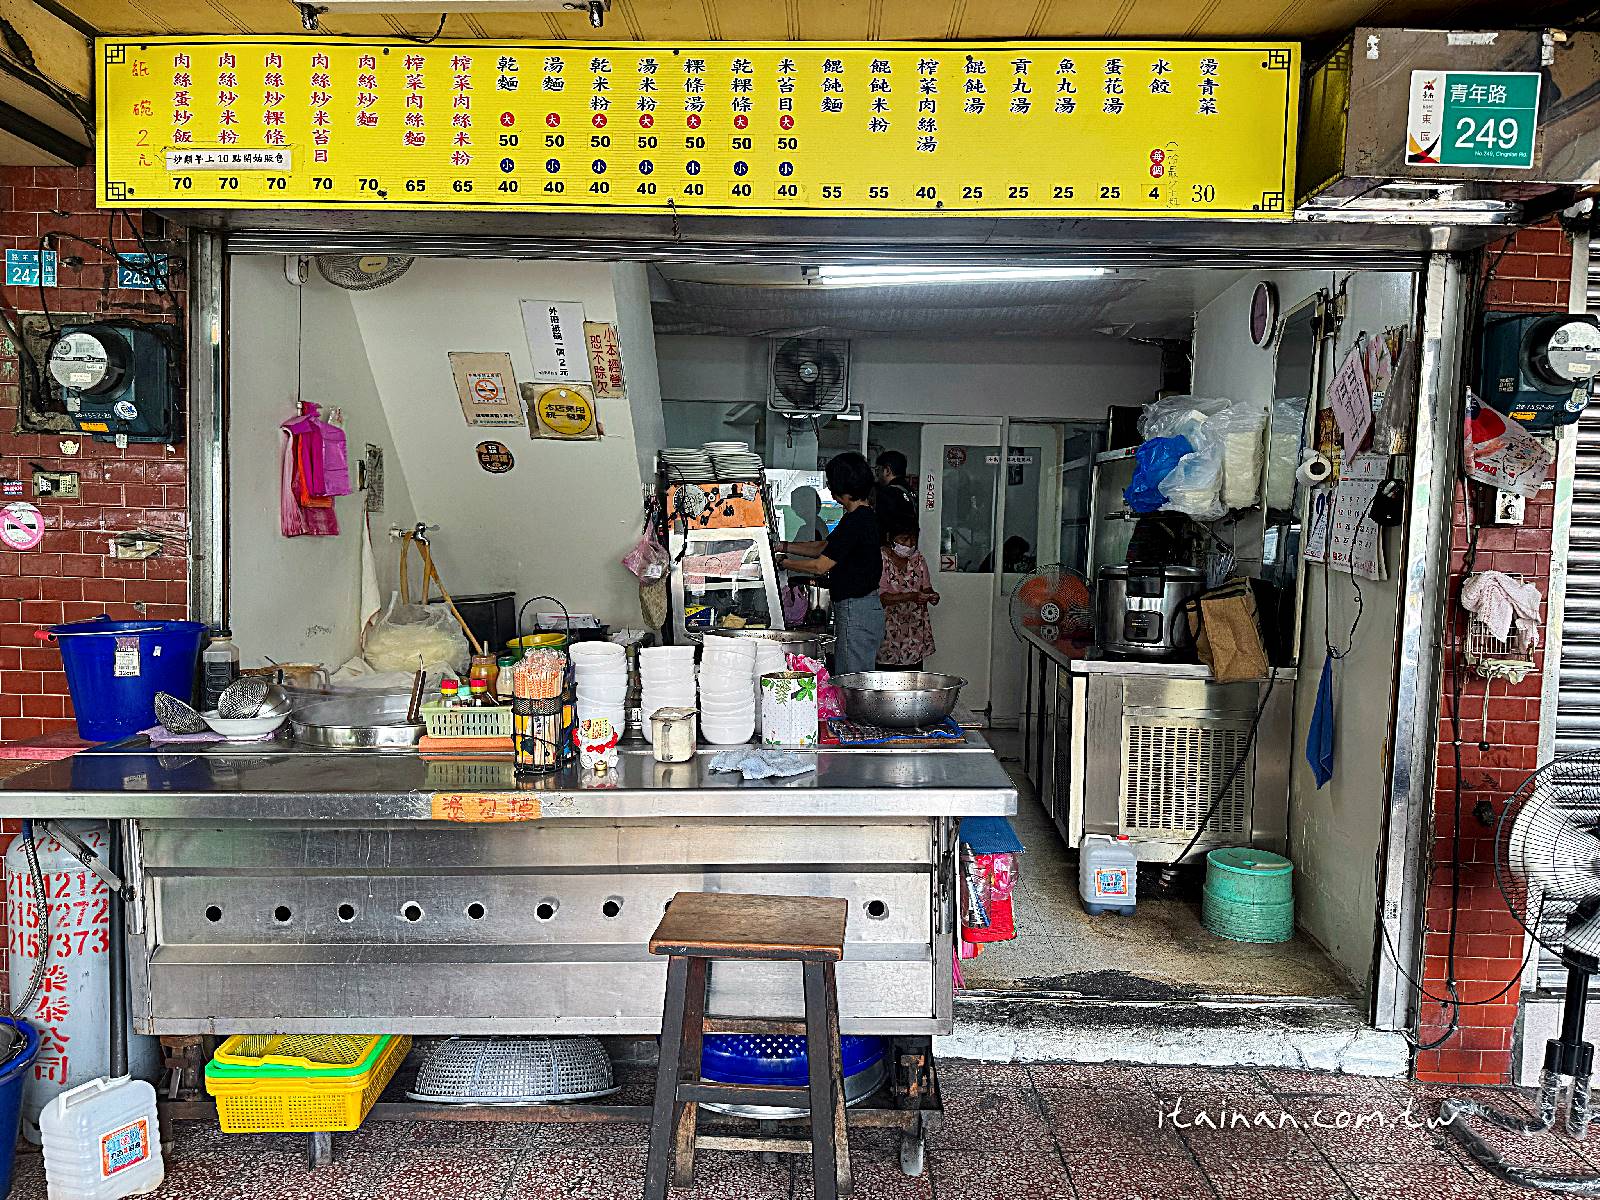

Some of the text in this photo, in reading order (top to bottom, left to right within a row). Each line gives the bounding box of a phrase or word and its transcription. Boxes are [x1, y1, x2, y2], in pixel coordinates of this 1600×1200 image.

[497, 56, 518, 91] 乾麵
[543, 57, 564, 91] 湯麵
[1149, 59, 1171, 93] 水餃
[357, 55, 378, 126] 肉絲炒麵
[590, 58, 611, 110] 乾米粉
[637, 59, 658, 111] 湯米粉
[684, 59, 705, 112] 粿條湯
[731, 59, 753, 112] 乾粿條
[778, 59, 796, 111] 米苔目
[821, 59, 843, 112] 餛飩麵
[963, 60, 986, 114] 餛飩湯
[1010, 59, 1032, 114] 貢丸湯
[1055, 59, 1076, 113] 魚丸湯
[1103, 59, 1124, 114] 蛋花湯
[1198, 59, 1219, 114] 燙青菜
[173, 53, 193, 143] 肉絲蛋炒飯
[218, 53, 239, 144] 肉絲炒米粉
[264, 53, 285, 144] 肉絲炒粿條
[869, 59, 891, 132] 餛飩米粉
[1450, 83, 1507, 103] 青年路
[405, 55, 425, 146] 榨菜肉絲麵
[917, 59, 939, 152] 榨菜肉絲湯
[1455, 117, 1519, 149] 249
[499, 135, 518, 146] 50
[545, 135, 564, 147] 50
[591, 136, 610, 147] 50
[638, 137, 657, 148] 50
[685, 137, 705, 148] 50
[732, 138, 751, 149] 50
[778, 138, 797, 149] 50
[1149, 150, 1164, 199] 每個 4
[173, 177, 191, 189] 70
[219, 178, 238, 189] 70
[267, 178, 286, 189] 70
[313, 178, 332, 189] 70
[359, 179, 379, 190] 70
[406, 180, 425, 191] 65
[453, 180, 472, 192] 65
[498, 181, 518, 192] 40
[544, 182, 564, 193] 40
[589, 182, 609, 193] 40
[637, 183, 656, 194] 40
[684, 184, 703, 195] 40
[732, 184, 751, 196] 40
[778, 185, 797, 196] 40
[823, 186, 841, 198] 55
[869, 187, 888, 198] 55
[916, 187, 936, 198] 40
[963, 187, 982, 198] 25
[1009, 187, 1028, 198] 25
[1053, 187, 1073, 198] 25
[1100, 187, 1120, 198] 25
[1192, 185, 1214, 202] 30
[13, 267, 39, 283] 247
[603, 327, 622, 388] 小本經營
[29, 965, 69, 1085] 榮泰公司
